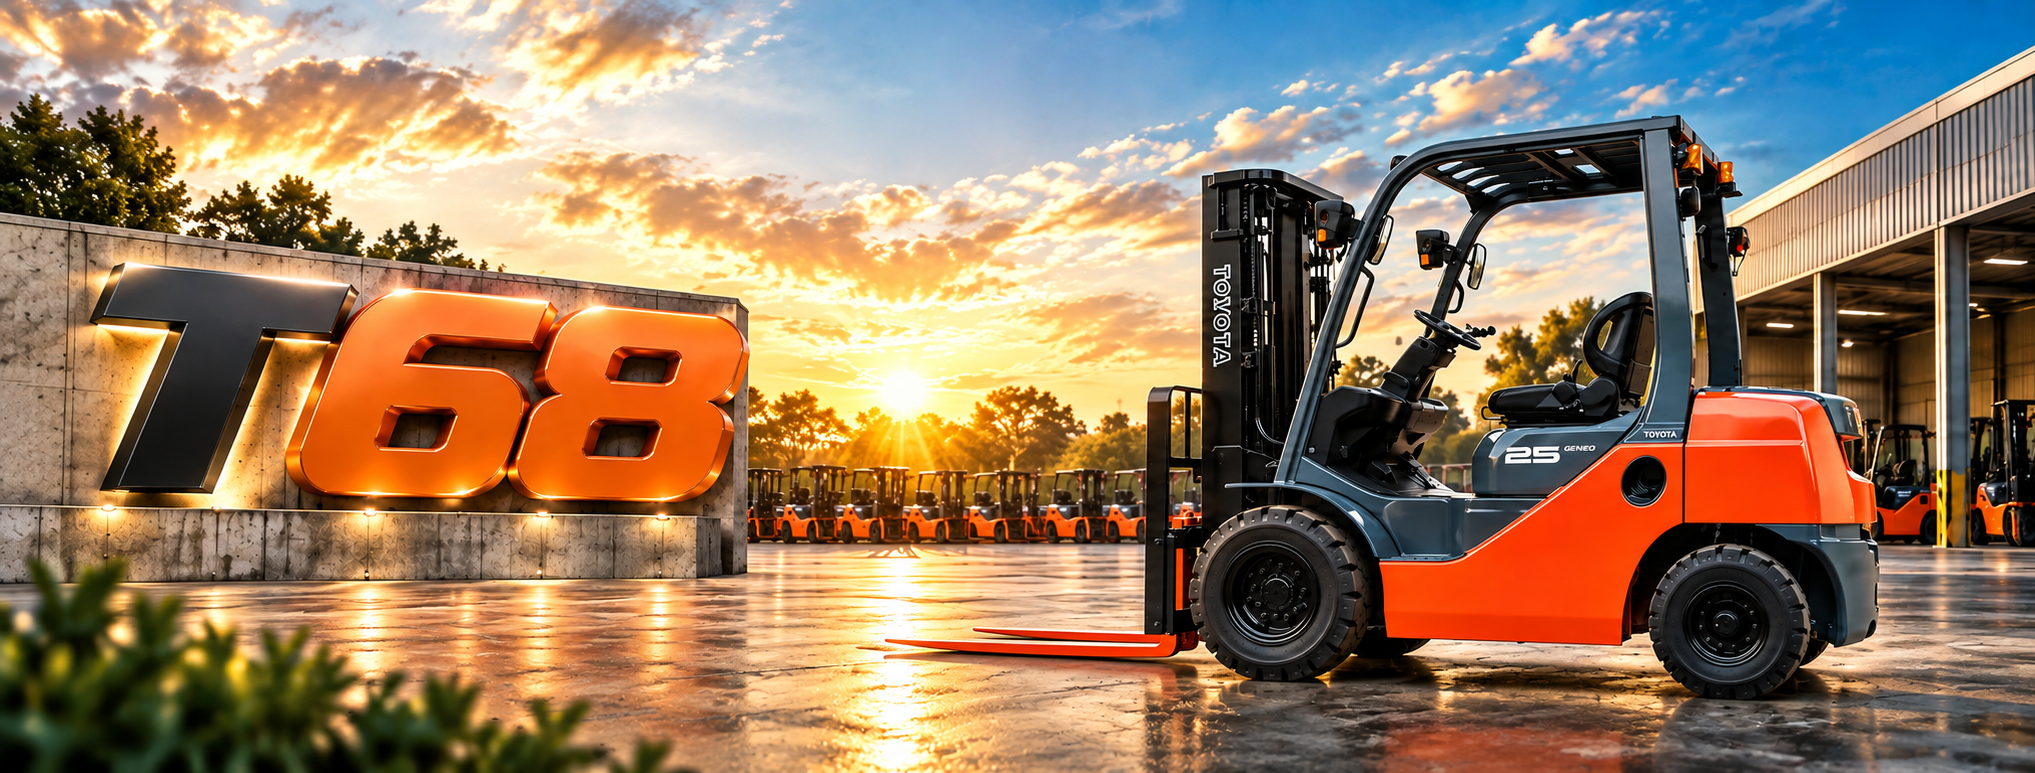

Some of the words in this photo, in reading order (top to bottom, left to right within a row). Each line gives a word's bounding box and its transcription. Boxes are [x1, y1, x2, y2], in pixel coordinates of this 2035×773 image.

[1213, 264, 1231, 367] TOYOTA
[89, 262, 749, 501] T68
[1505, 446, 1561, 464] 25
